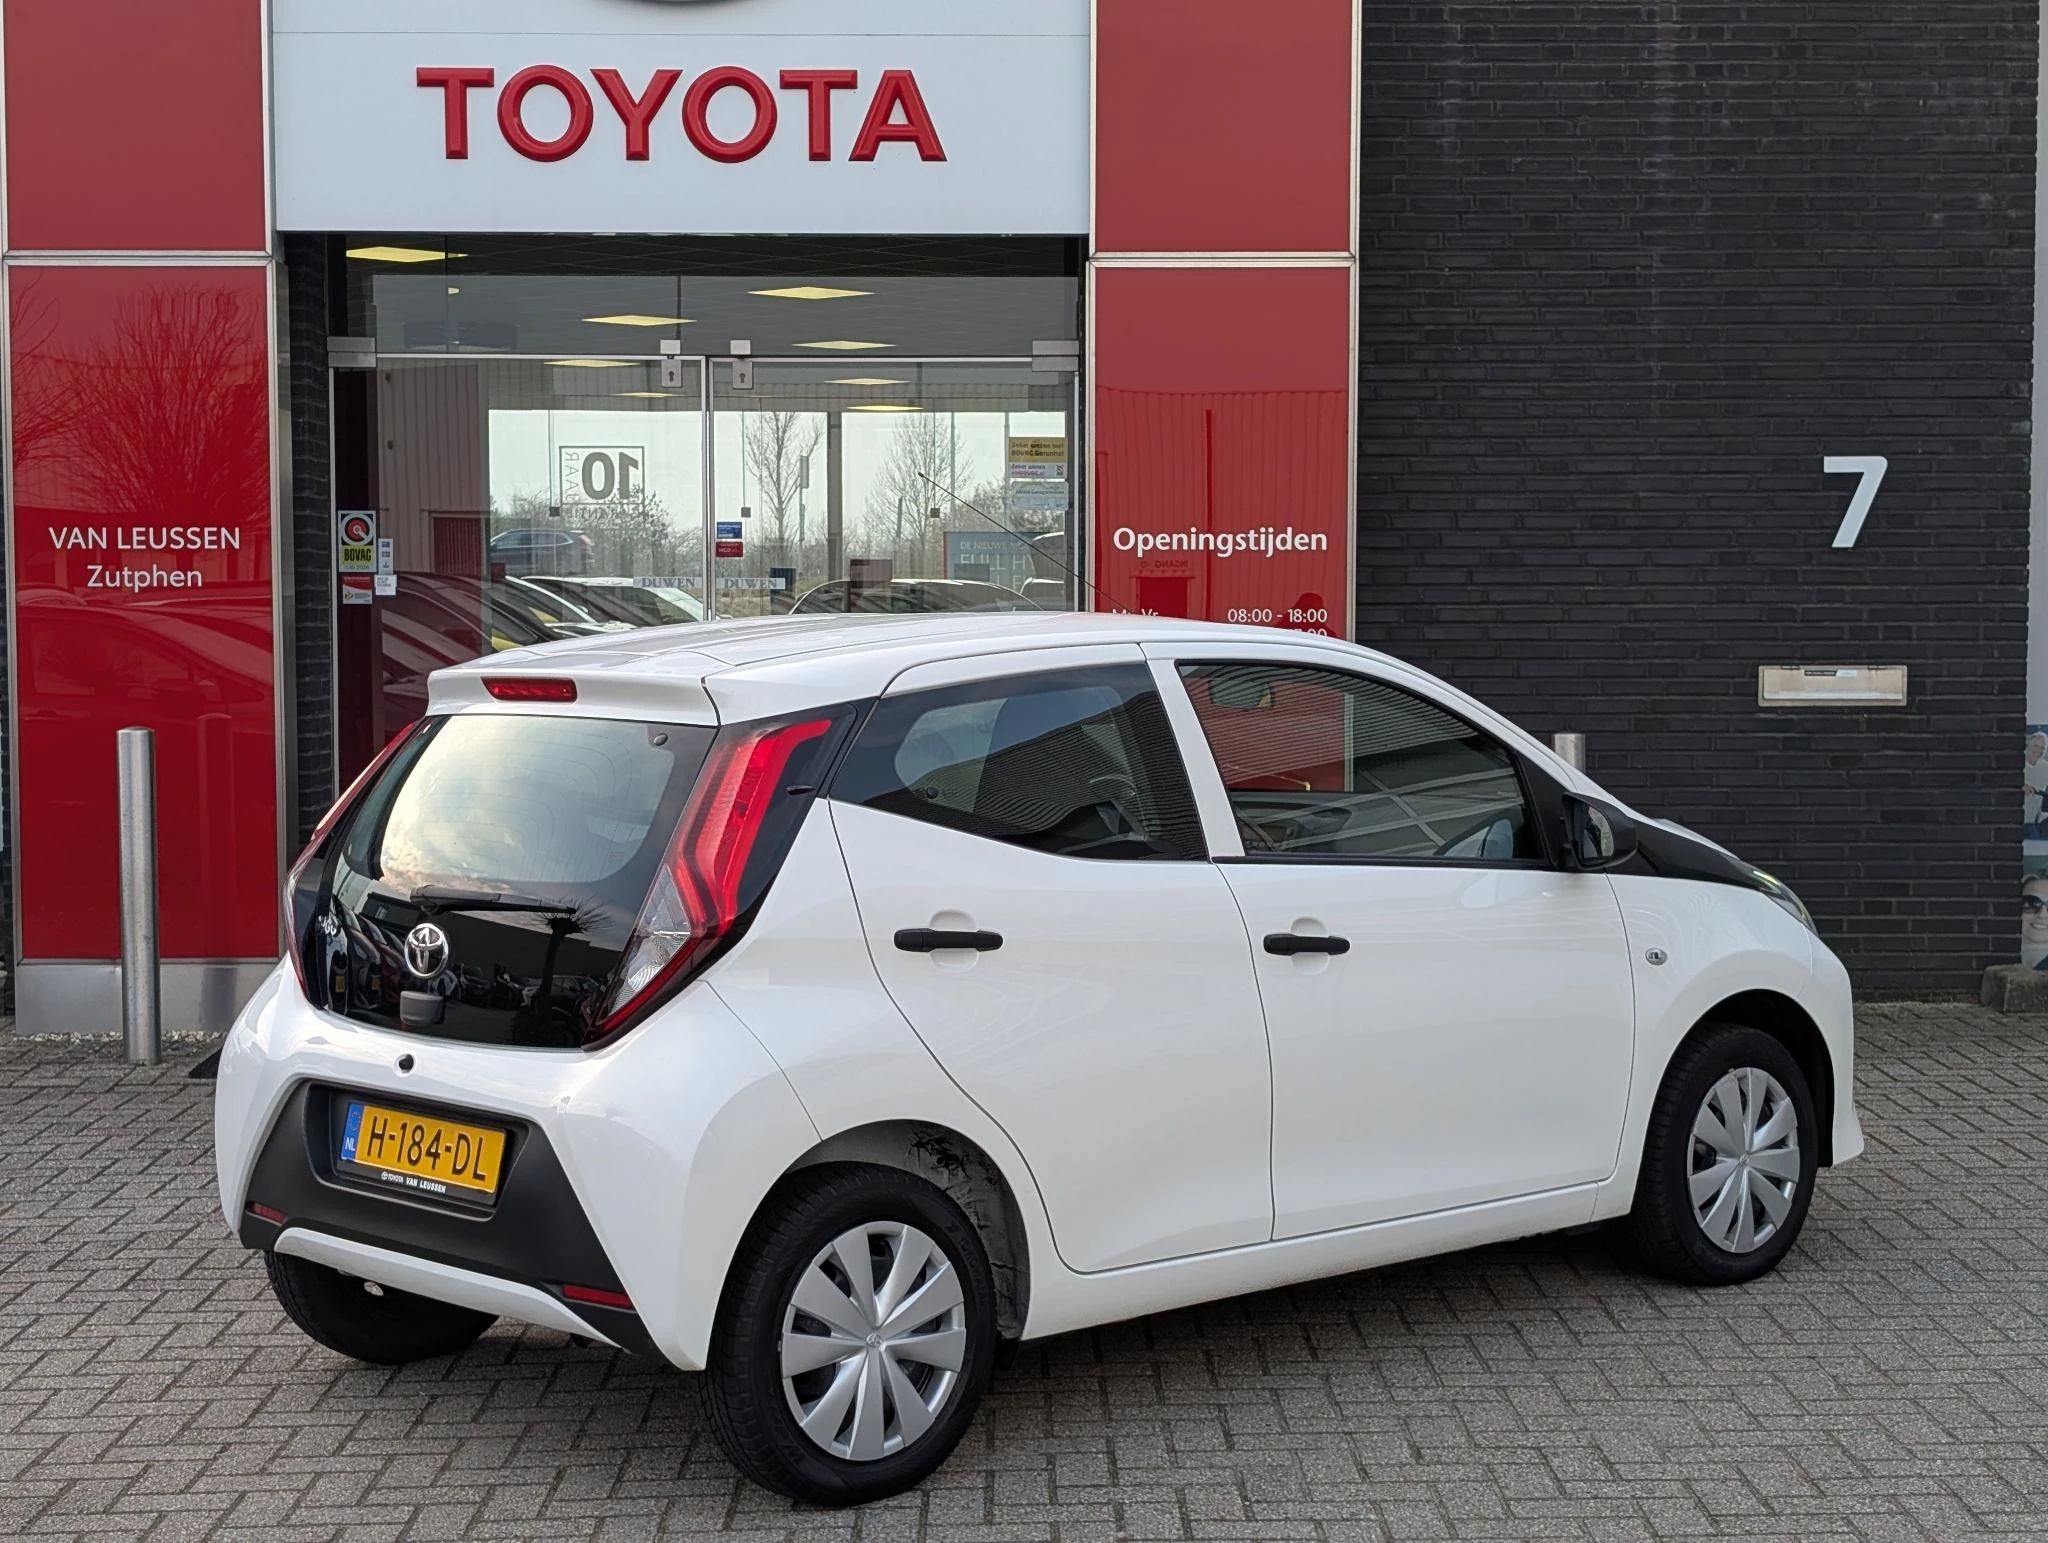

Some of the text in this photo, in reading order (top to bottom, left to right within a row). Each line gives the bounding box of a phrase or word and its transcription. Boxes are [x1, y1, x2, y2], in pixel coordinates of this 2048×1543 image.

[416, 64, 948, 164] TOYOTA
[1823, 455, 1888, 548] 7
[48, 526, 241, 550] VAN LEUSSEN
[1113, 526, 1328, 558] Openingstijden
[344, 548, 372, 562] BOVAG
[87, 563, 203, 594] Zutphen
[641, 576, 695, 588] DUWEN
[724, 577, 777, 589] DUWEN
[1227, 608, 1273, 623] 08:00
[1287, 608, 1328, 623] 18:00
[345, 1138, 356, 1152] NL
[366, 1115, 487, 1182] H-184-DL
[406, 1176, 418, 1187] VAN
[419, 1180, 447, 1194] LEUSSEN
